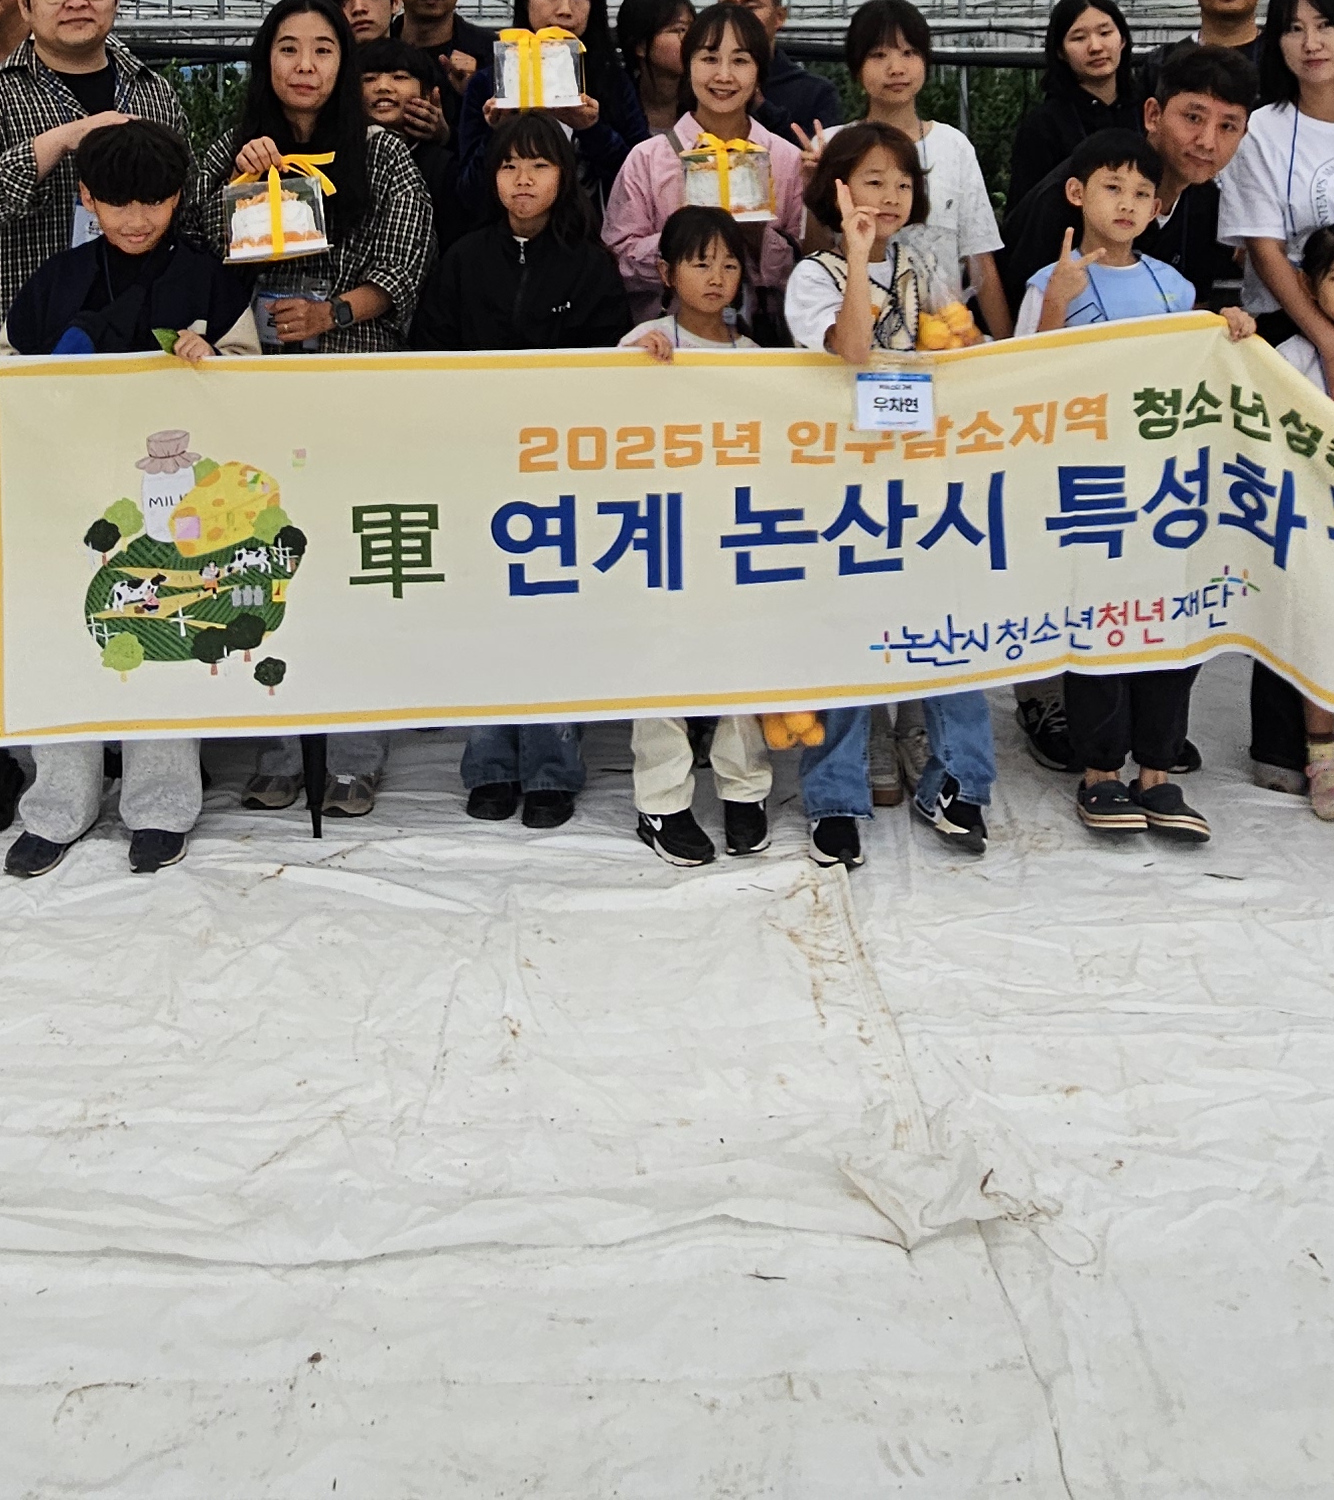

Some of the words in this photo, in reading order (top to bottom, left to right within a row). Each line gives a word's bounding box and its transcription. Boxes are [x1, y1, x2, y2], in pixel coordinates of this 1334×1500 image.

[519, 421, 761, 473] 2025년
[149, 493, 188, 508] MIL
[349, 503, 445, 599] 軍
[491, 491, 684, 597] 연계
[720, 470, 1009, 585] 논산시
[1045, 445, 1307, 571] 특성화
